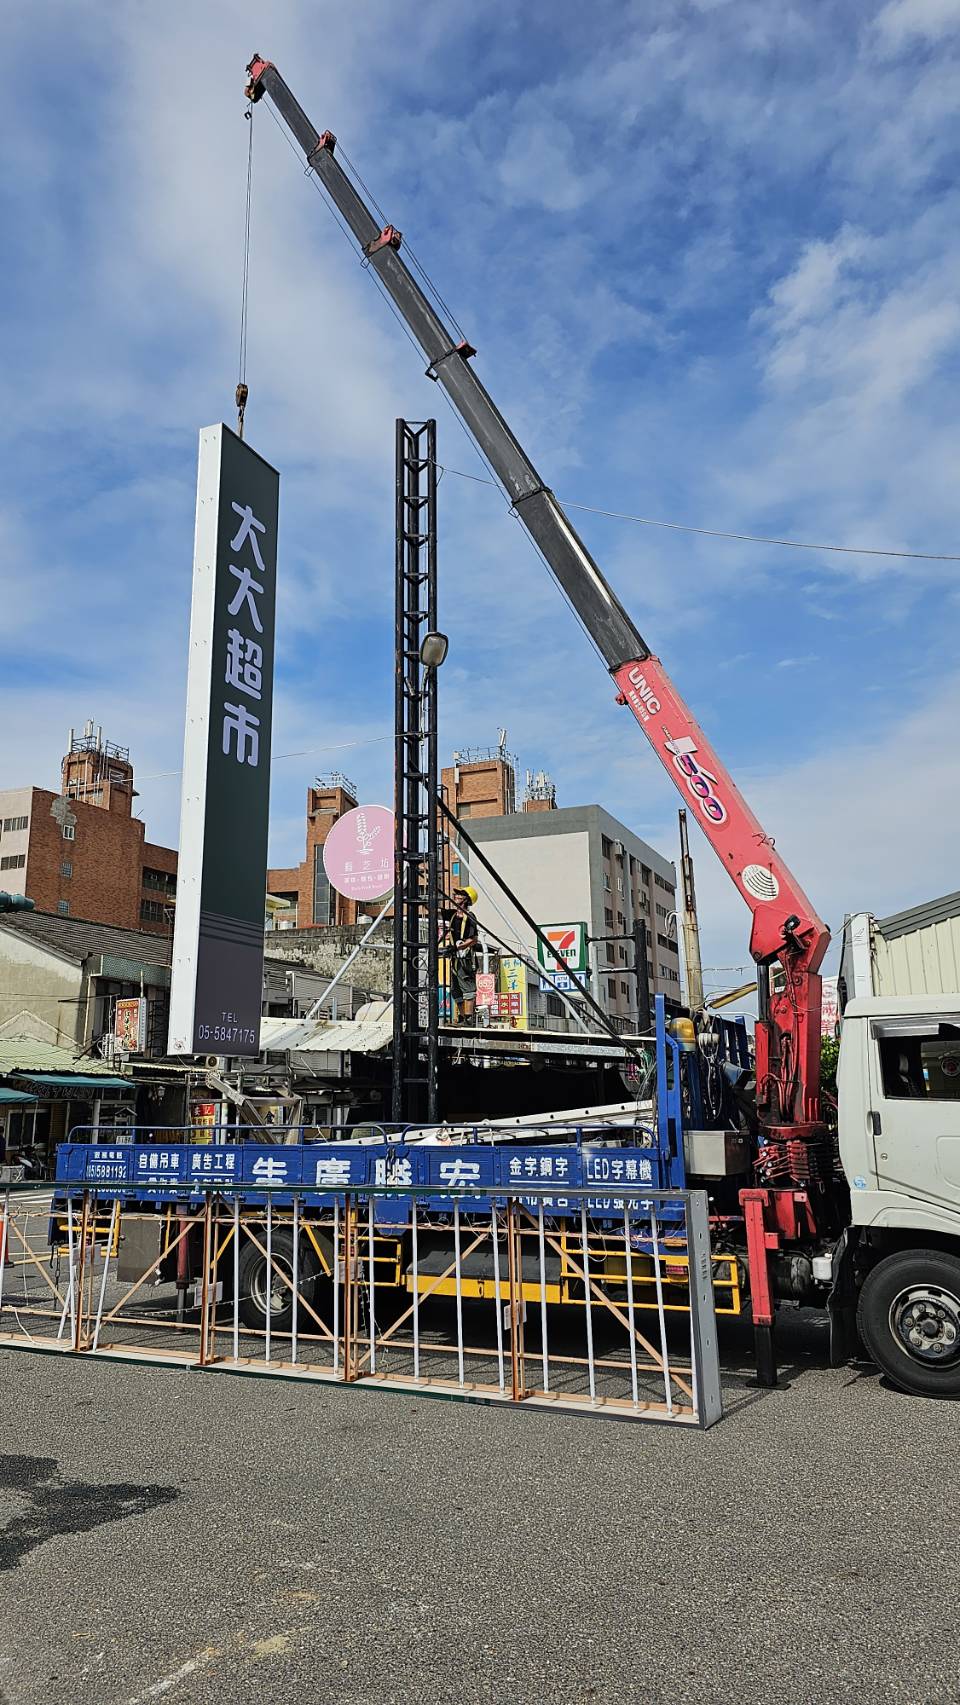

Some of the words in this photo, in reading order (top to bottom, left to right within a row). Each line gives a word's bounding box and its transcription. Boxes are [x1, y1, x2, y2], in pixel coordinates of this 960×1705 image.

[222, 502, 266, 766] 大大超市
[628, 667, 661, 715] UNIC
[547, 931, 576, 970] 7
[221, 1012, 238, 1023] TEL
[198, 1025, 255, 1043] 05-5847175
[139, 1153, 180, 1169] 自備吊車
[192, 1153, 235, 1170] 廣告工程
